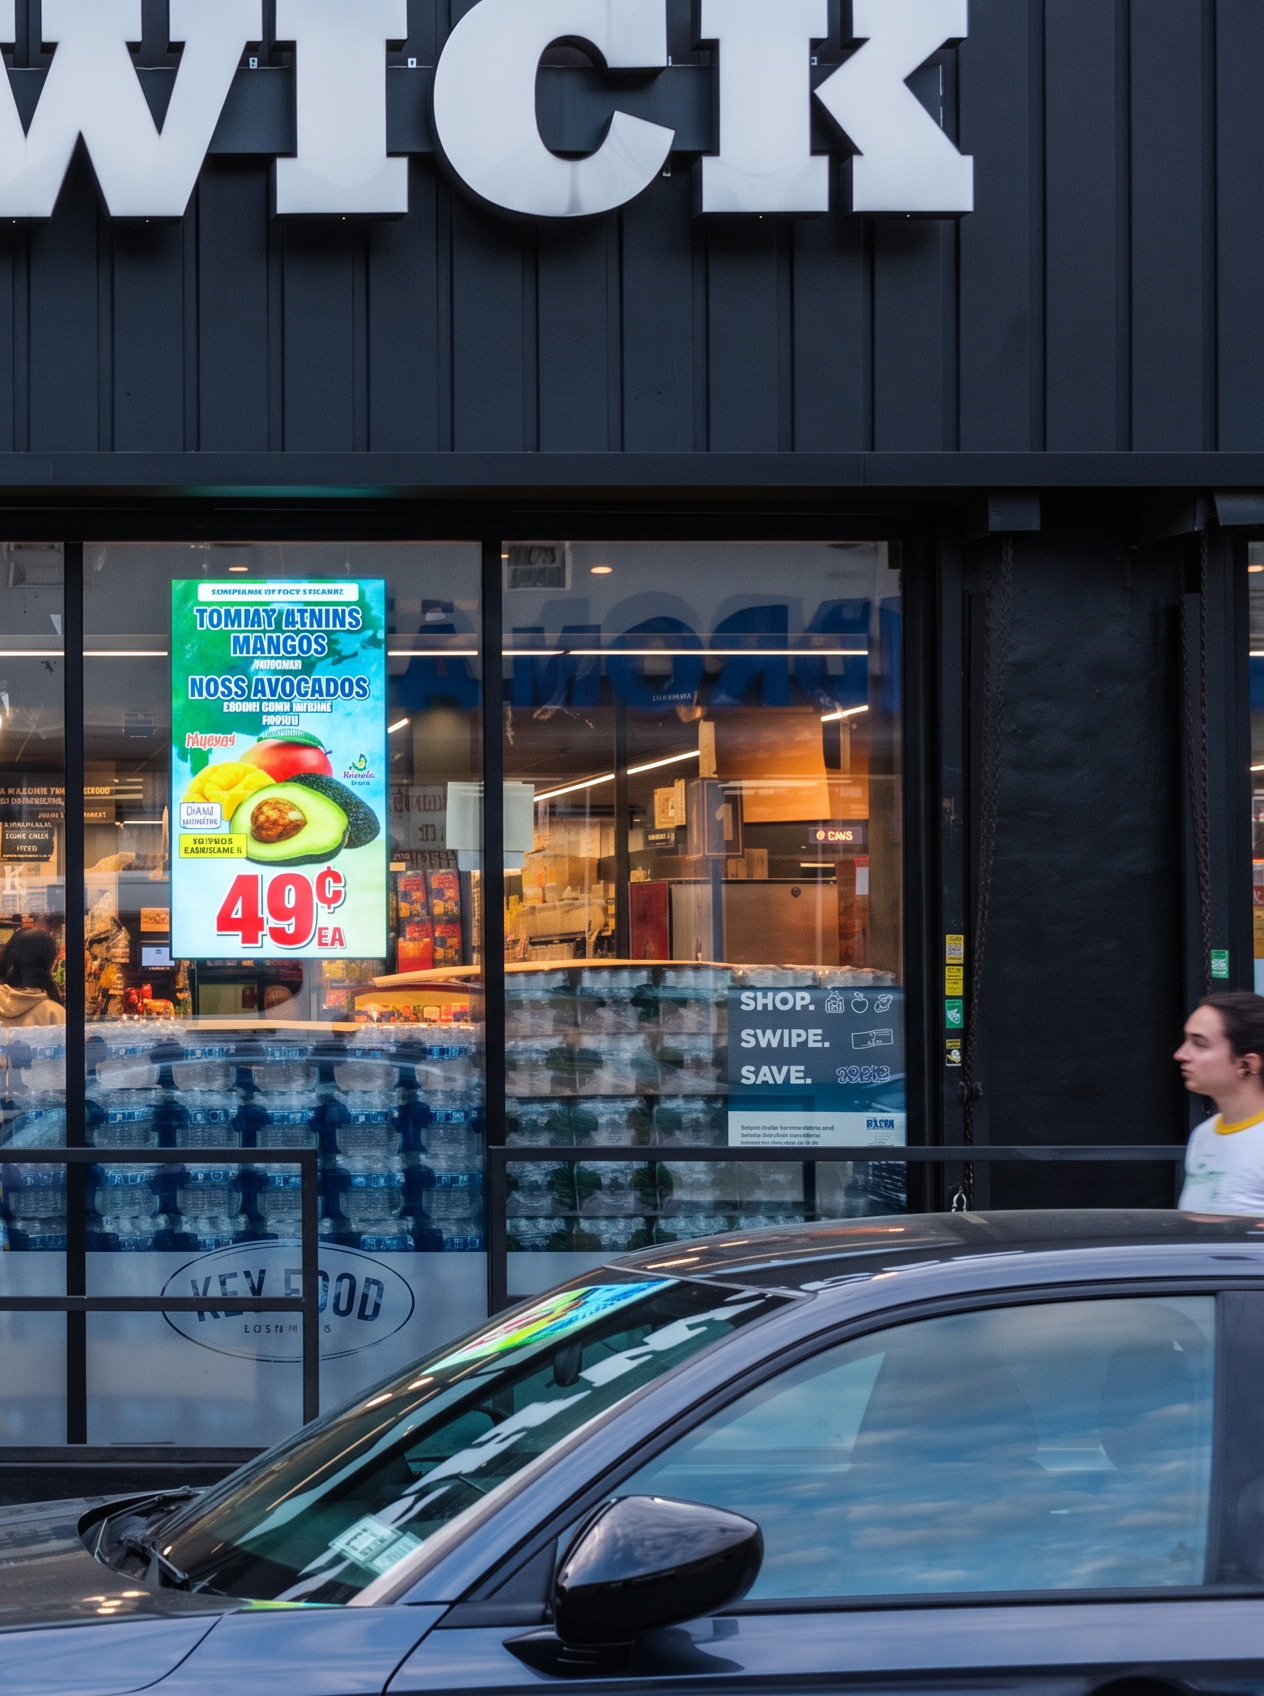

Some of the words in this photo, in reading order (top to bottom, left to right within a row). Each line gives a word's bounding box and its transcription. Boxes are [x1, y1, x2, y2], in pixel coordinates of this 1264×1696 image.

[231, 633, 327, 656] MANGOS
[189, 676, 247, 699] NOSS
[251, 676, 370, 699] AVOCADOS
[715, 803, 734, 841] 1
[317, 927, 345, 948] EA
[740, 991, 815, 1011] SHOP.
[740, 1028, 830, 1048] SWIPE.
[740, 1065, 812, 1085] SAVE.
